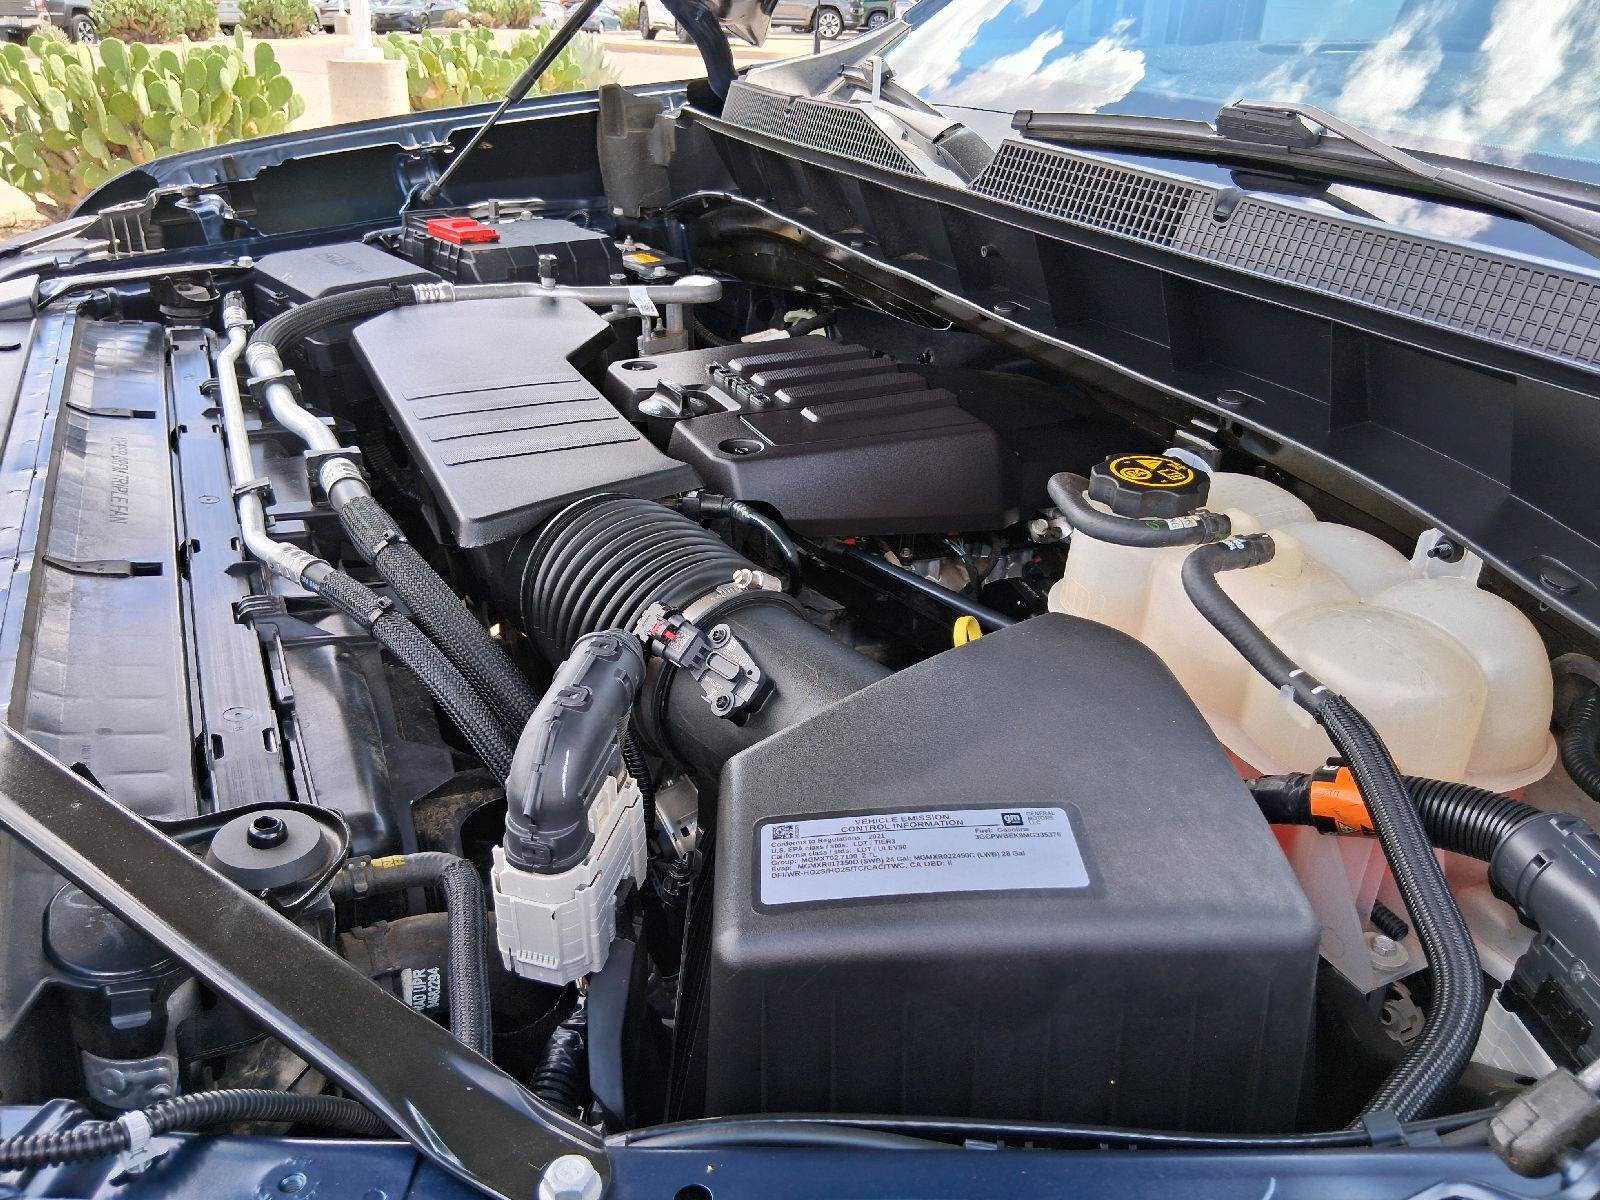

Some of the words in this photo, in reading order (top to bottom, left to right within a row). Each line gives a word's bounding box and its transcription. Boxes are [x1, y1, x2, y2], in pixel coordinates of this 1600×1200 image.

[855, 816, 898, 825] VEHICLE
[901, 814, 950, 822] EMISSION
[841, 823, 891, 832] CONTROL
[893, 820, 964, 829] INFORMATION
[771, 840, 807, 848] Conforms
[771, 851, 806, 860] California
[412, 968, 427, 992] UPR
